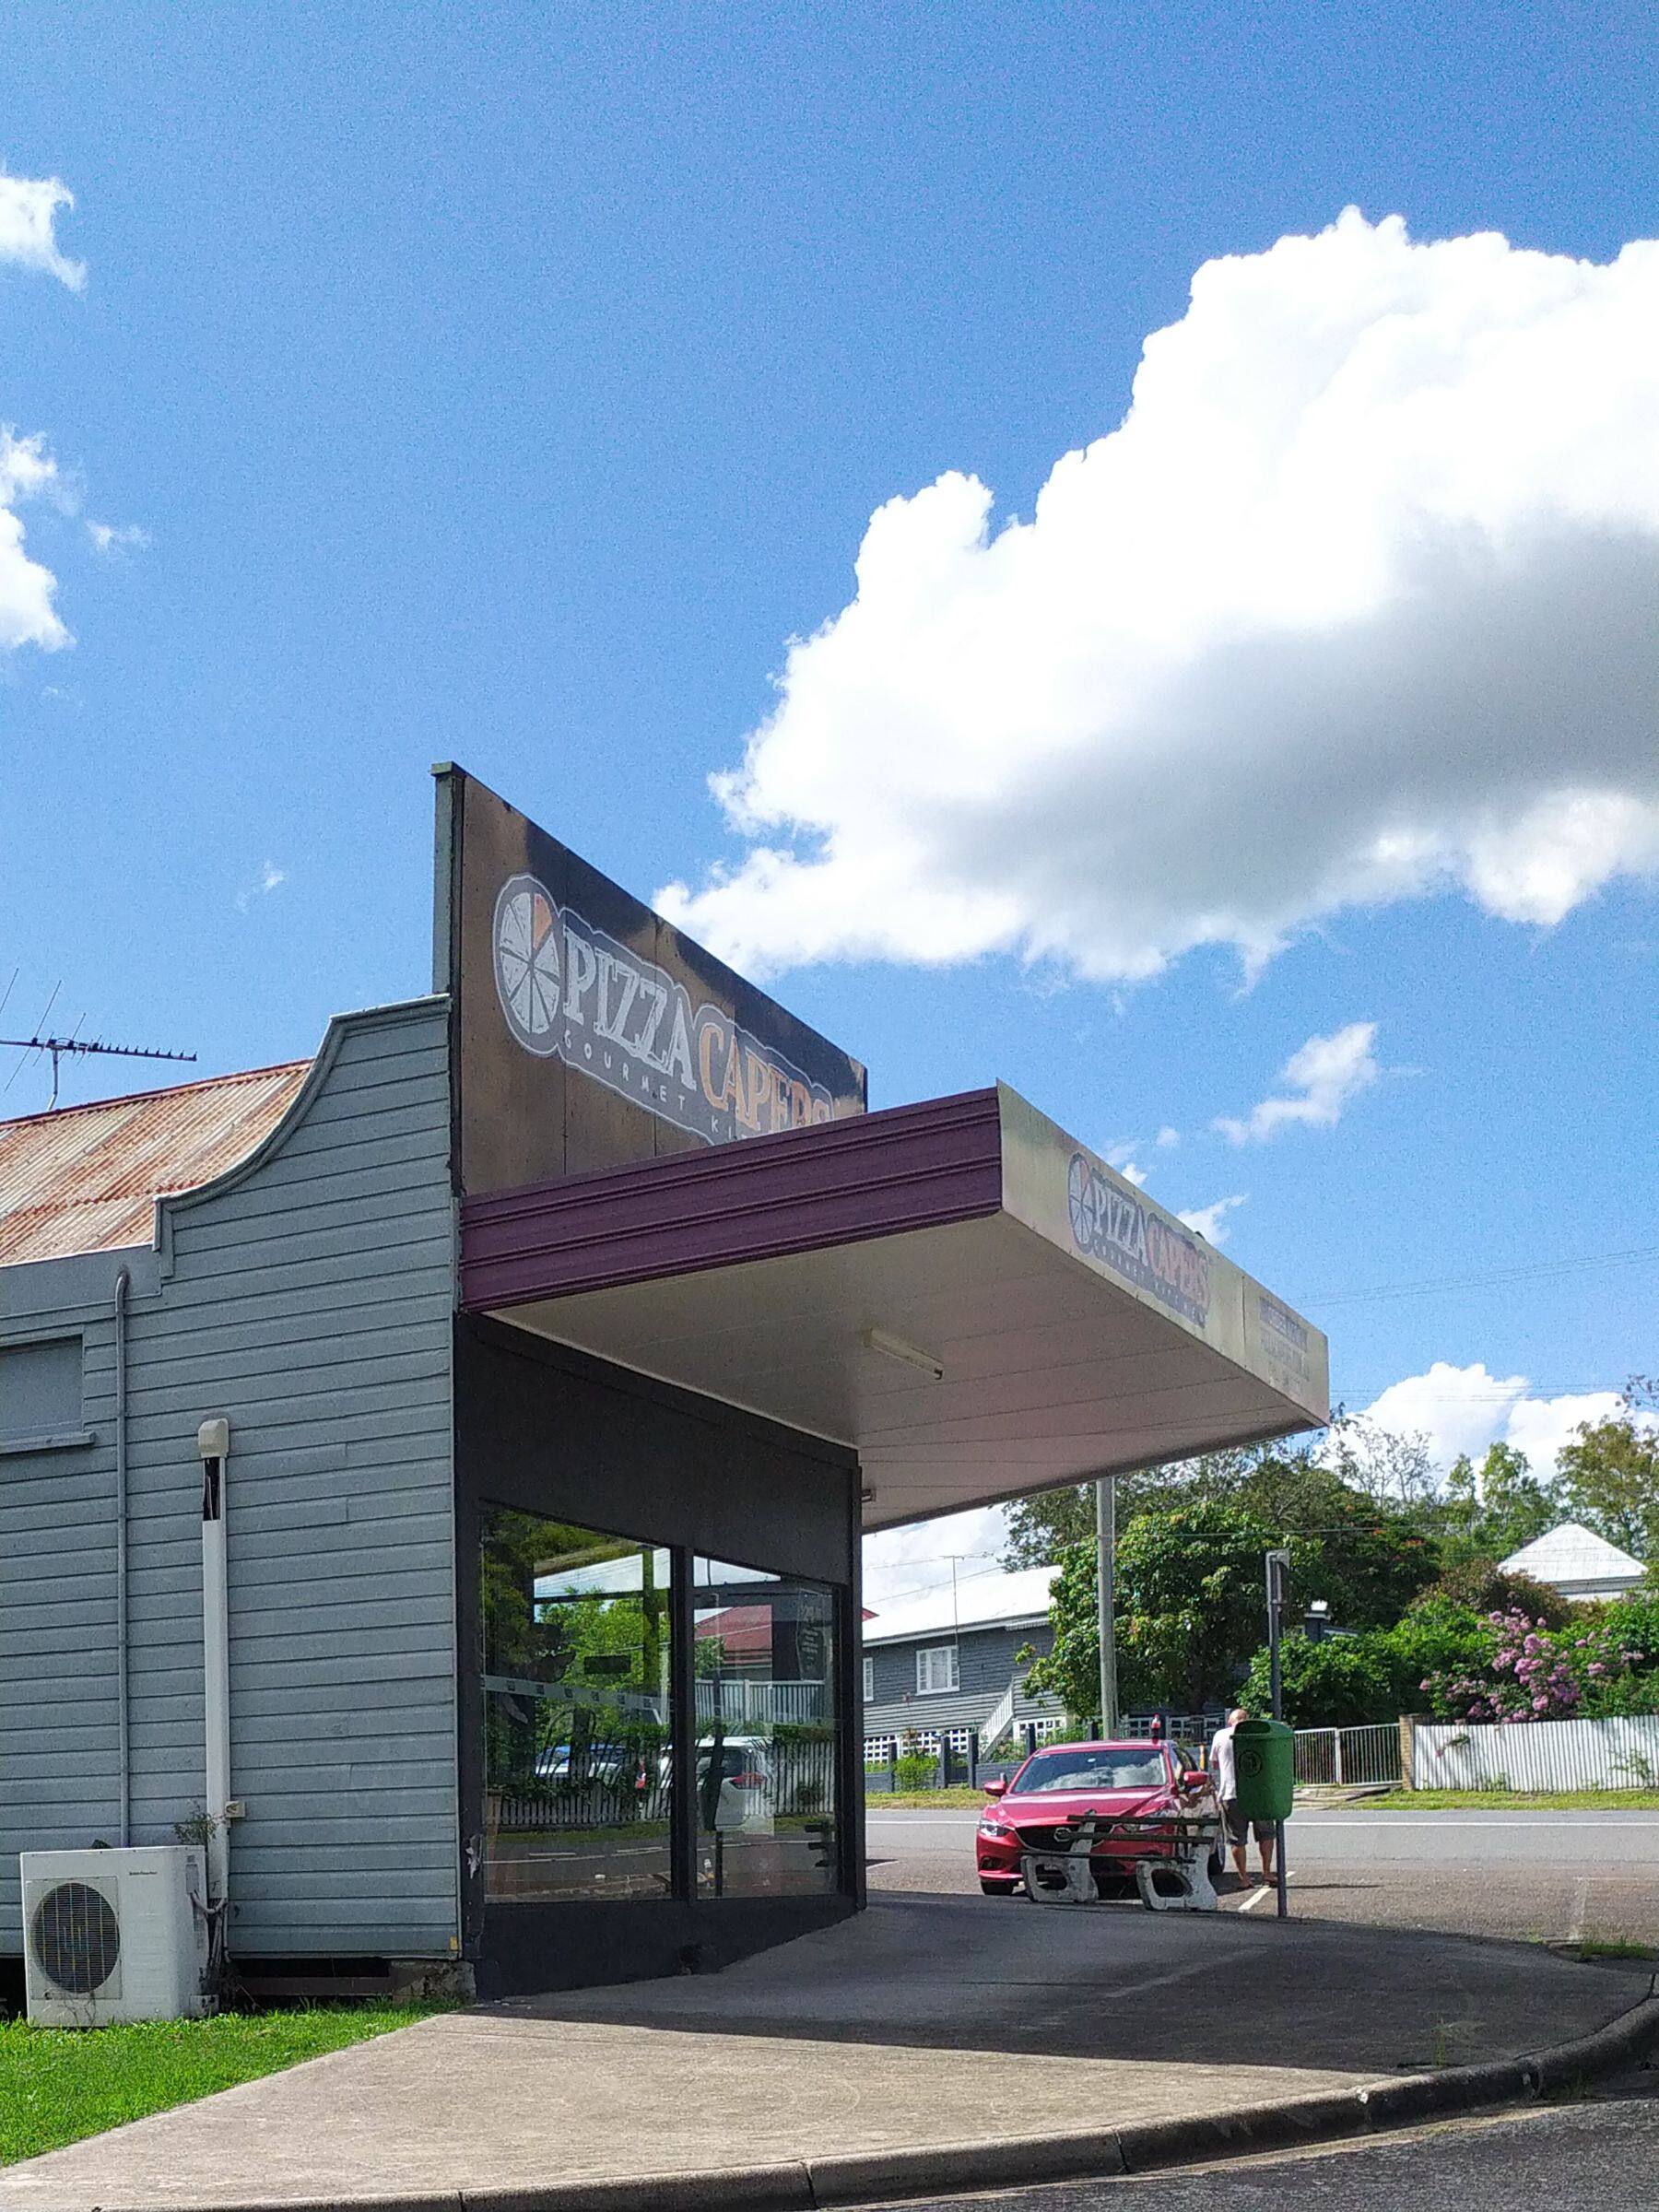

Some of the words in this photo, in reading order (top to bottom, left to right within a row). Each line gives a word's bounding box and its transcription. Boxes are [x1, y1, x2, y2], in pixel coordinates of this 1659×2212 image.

[563, 925, 697, 1090] PIZZA
[563, 1030, 686, 1112] GOURMET
[1091, 1177, 1148, 1267] PIZZA
